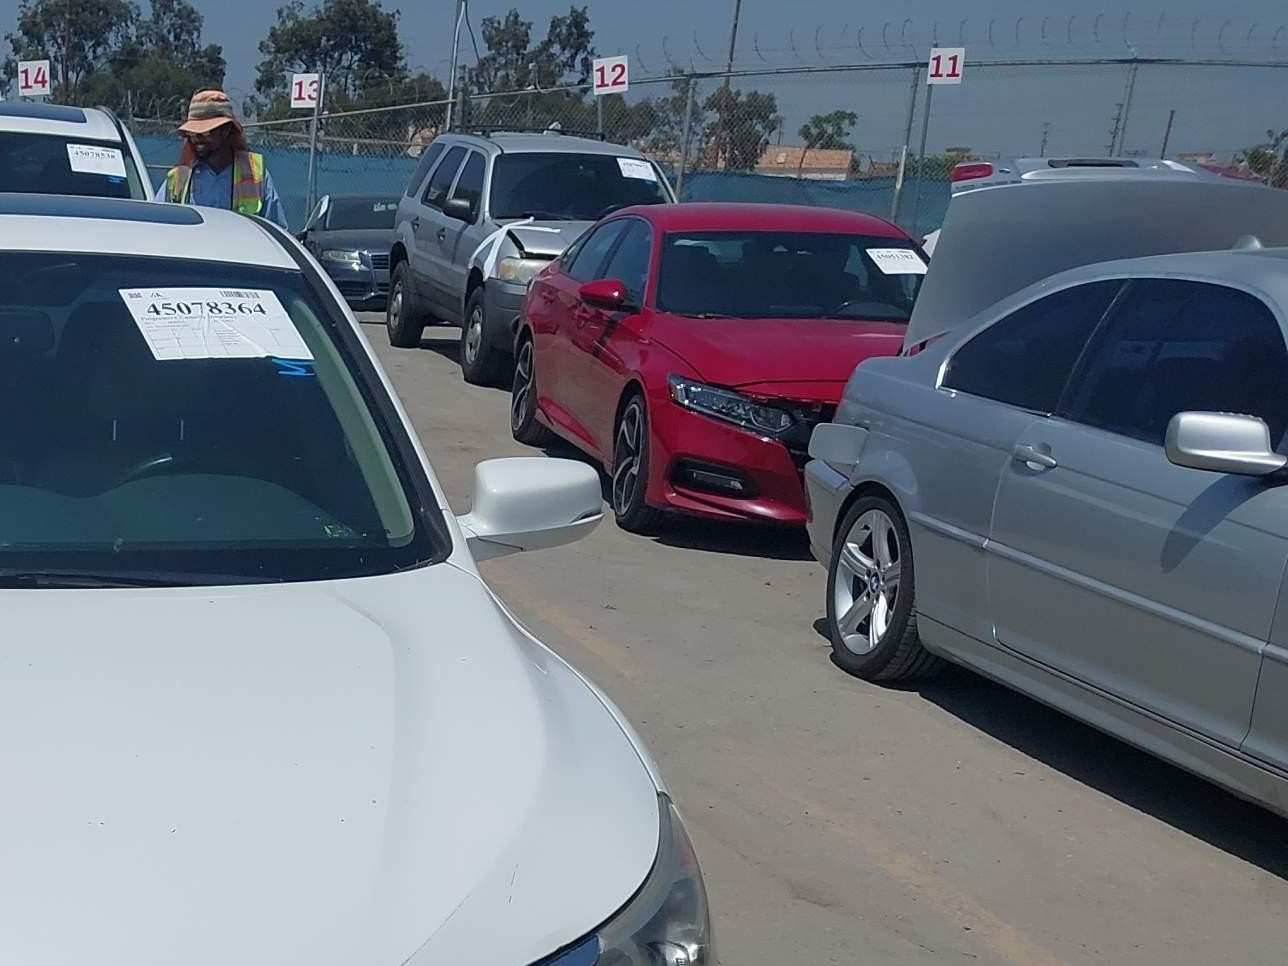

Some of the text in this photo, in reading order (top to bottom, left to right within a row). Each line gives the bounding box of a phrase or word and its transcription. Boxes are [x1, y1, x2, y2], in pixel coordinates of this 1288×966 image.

[595, 63, 626, 88] 12
[930, 55, 960, 77] 11
[20, 67, 48, 89] 14
[293, 80, 318, 101] 13
[147, 301, 267, 316] 45078364
